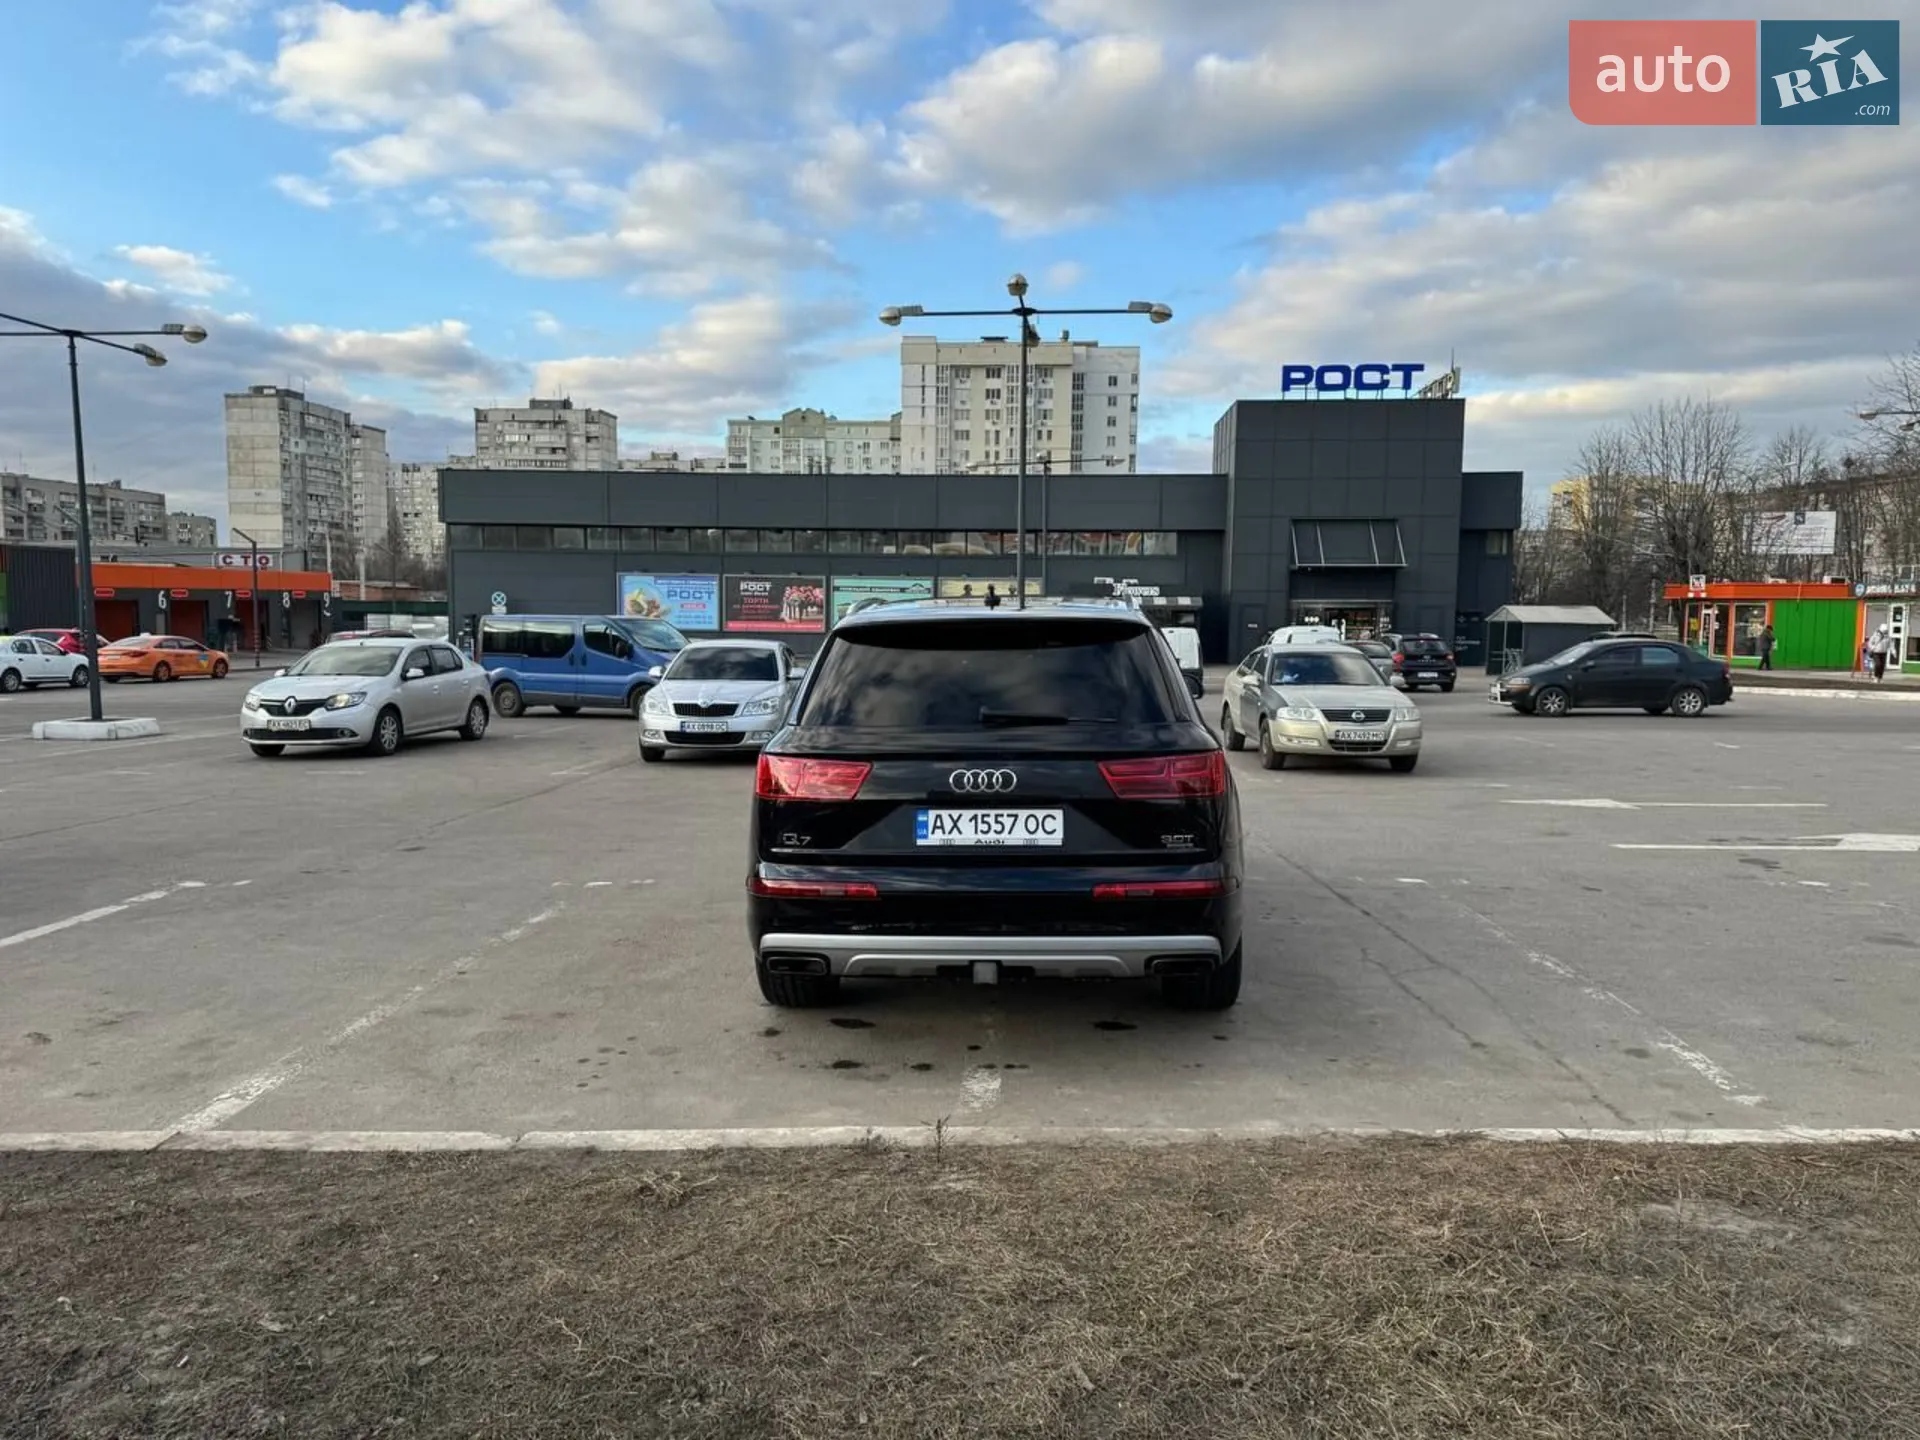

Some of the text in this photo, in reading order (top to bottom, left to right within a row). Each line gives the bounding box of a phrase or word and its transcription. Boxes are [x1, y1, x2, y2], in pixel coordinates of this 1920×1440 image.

[1281, 364, 1425, 392] РОСТ
[222, 554, 270, 566] СТО
[739, 580, 772, 591] РОСТ
[157, 590, 167, 609] 6
[224, 591, 233, 609] 7
[282, 592, 291, 608] 8
[667, 590, 714, 601] РОСТ
[931, 813, 1057, 835] AX 1557 OC
[782, 833, 813, 847] Q7
